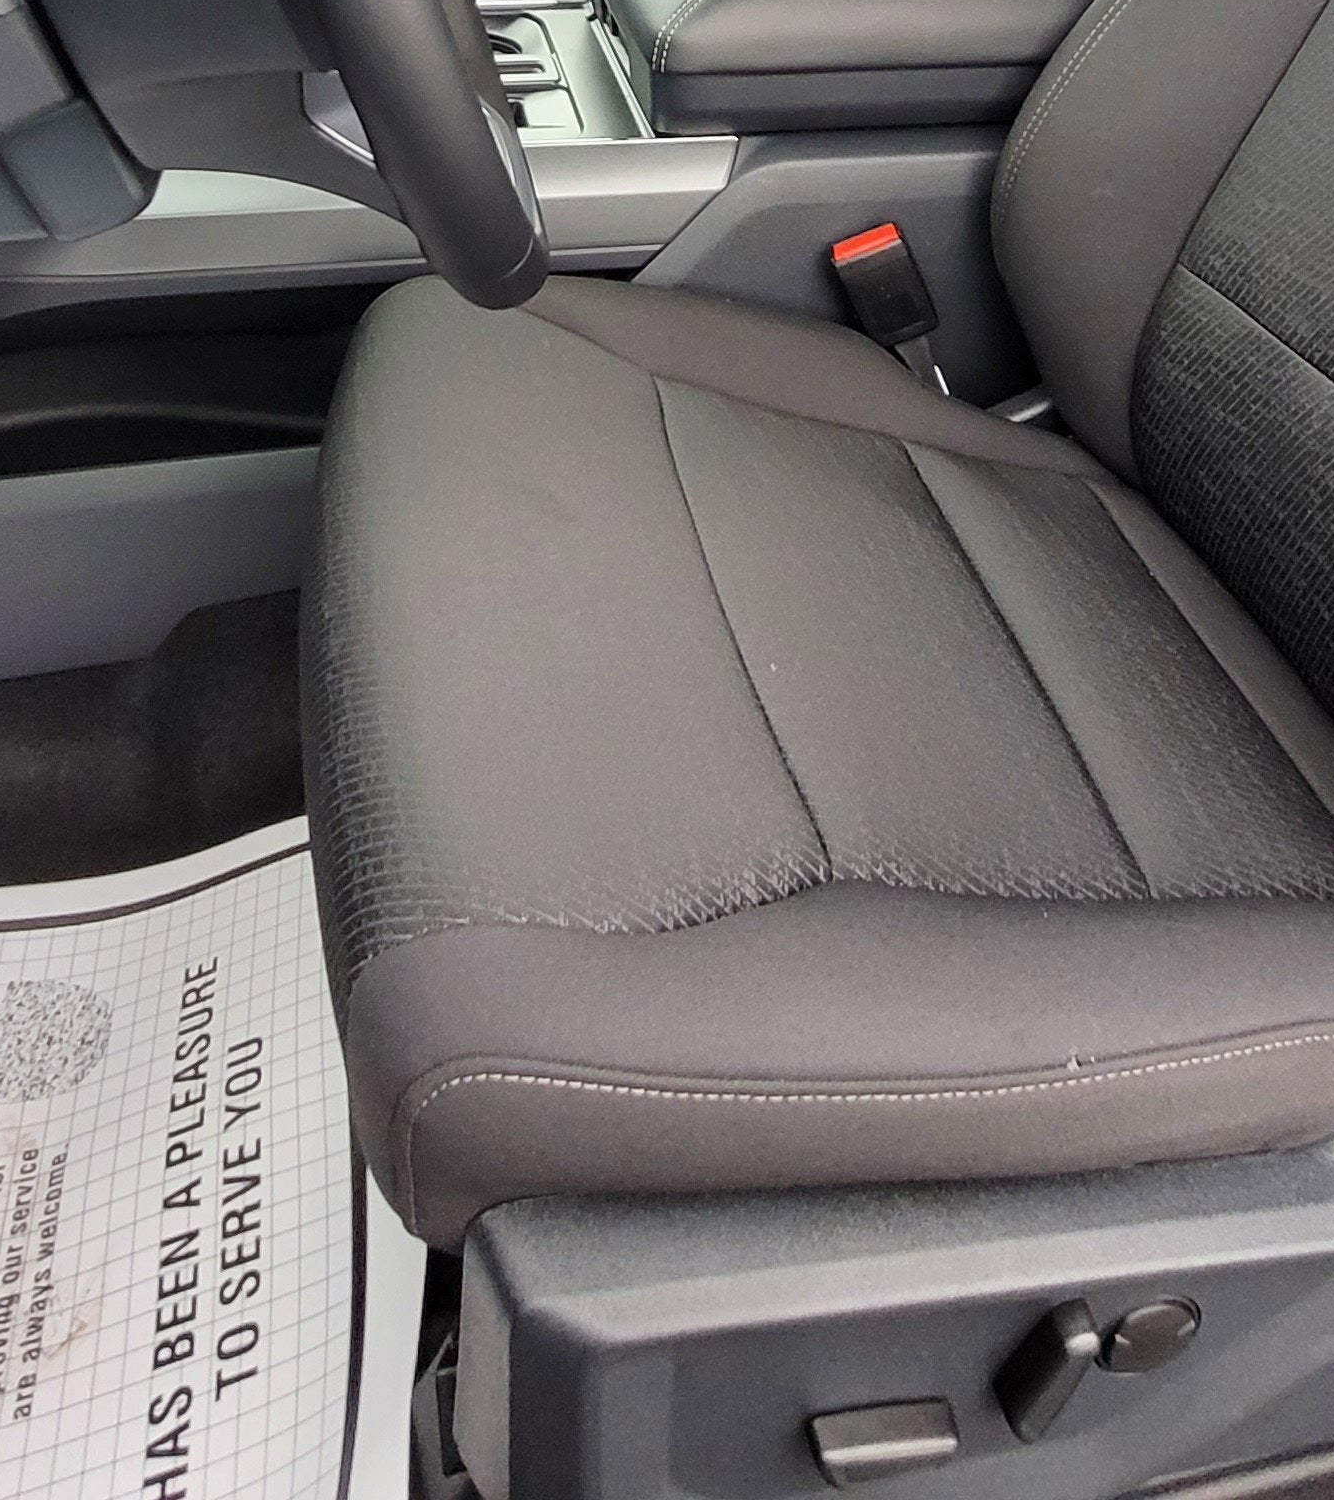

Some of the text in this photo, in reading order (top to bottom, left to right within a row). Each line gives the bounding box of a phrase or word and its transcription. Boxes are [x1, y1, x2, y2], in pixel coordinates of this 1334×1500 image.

[3, 1243, 24, 1285] our
[11, 1148, 40, 1235] service
[13, 1143, 69, 1420] are always welcome.
[142, 956, 218, 1500] HAS BEEN A PLEASURE
[215, 1036, 263, 1401] TO SERVE YOU
